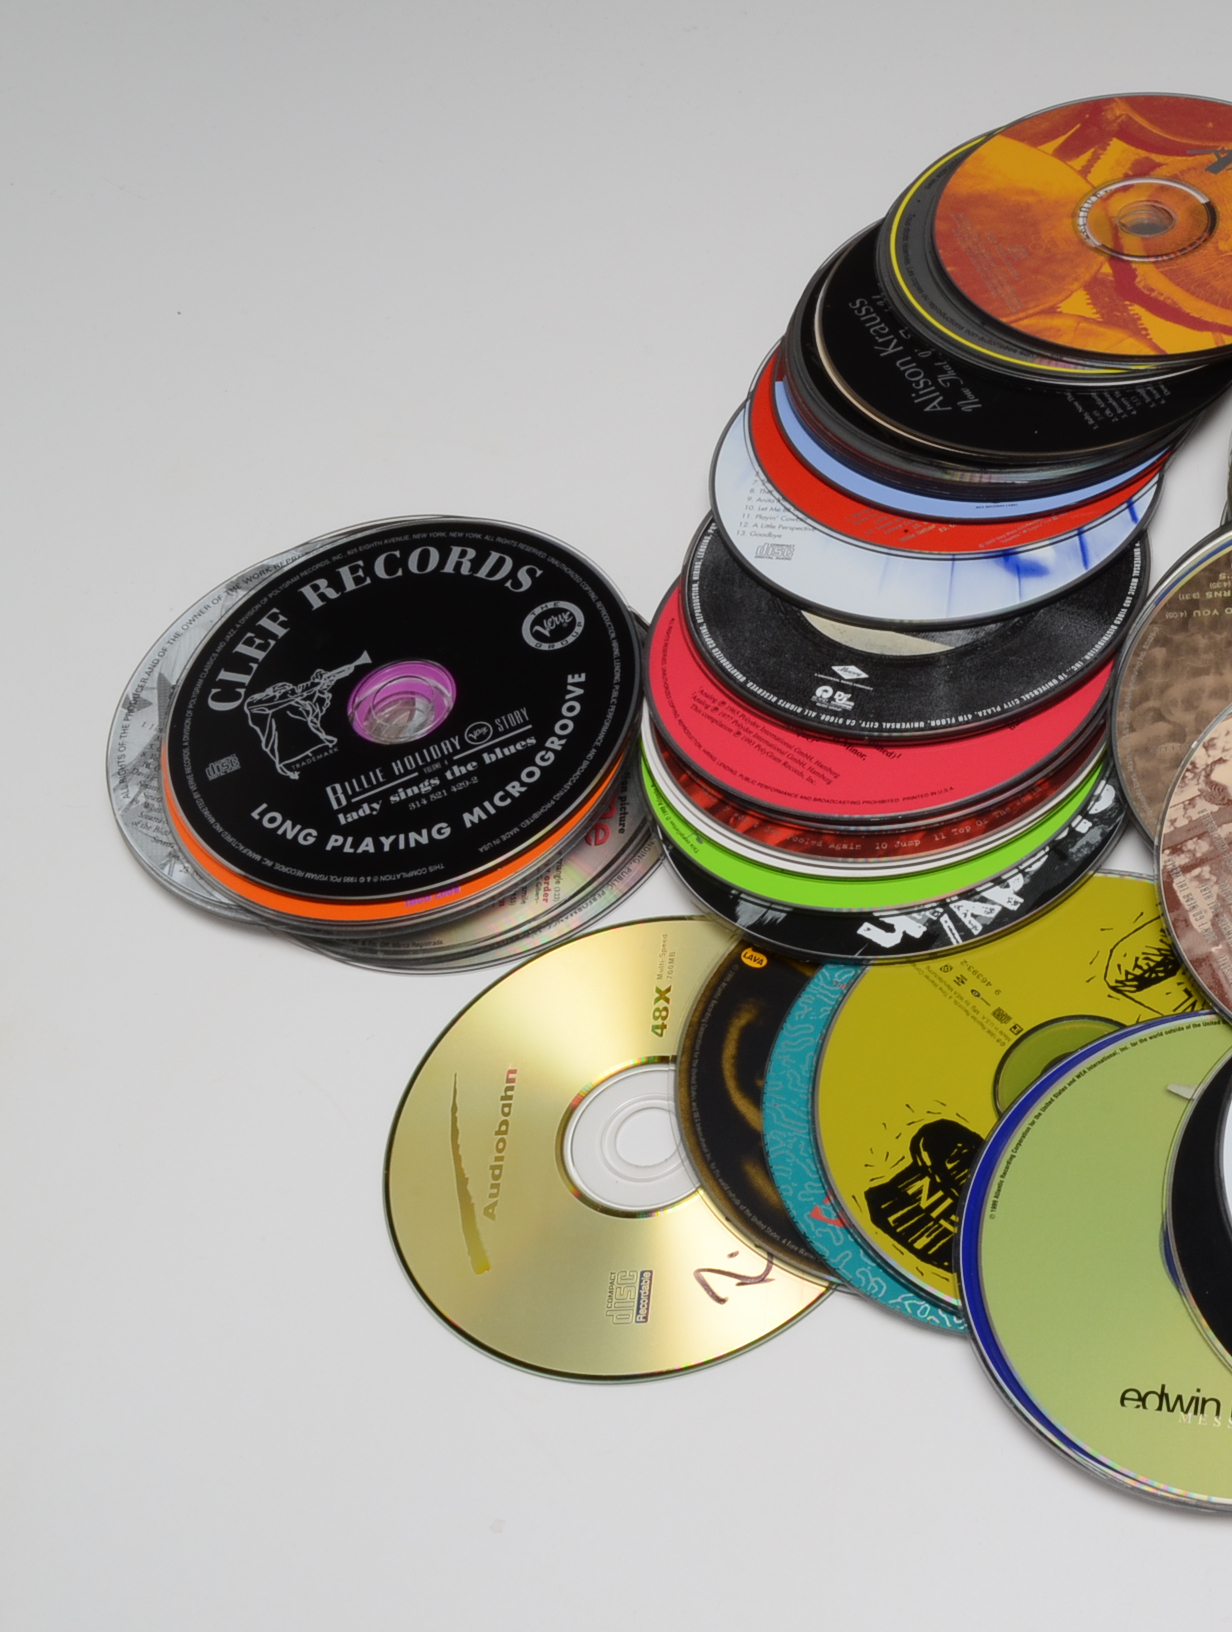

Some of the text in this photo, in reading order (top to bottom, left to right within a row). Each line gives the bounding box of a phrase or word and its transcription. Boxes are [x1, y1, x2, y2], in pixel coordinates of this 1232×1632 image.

[849, 298, 952, 412] Alison Krauss
[750, 530, 782, 539] Goodbye
[1116, 547, 1142, 625] UNIVERSAL MUSIC AND VIDEO
[181, 603, 212, 633] OWNER
[207, 545, 544, 712] CLEF RECORDS
[1193, 609, 1219, 617] YOU
[713, 649, 747, 683] UNAUTHORIZED
[777, 699, 803, 714] RIGHTS
[882, 720, 925, 729] UNIVERSAL
[250, 672, 586, 853] LONG PLAYING MICROGROOVE
[291, 746, 339, 770] TRADEMARK
[325, 707, 530, 811] BILLIE HOLIDAY STORY
[337, 735, 537, 826] lady sings the blues
[408, 796, 428, 811] 314
[429, 788, 448, 802] 521
[617, 792, 632, 835] picture
[894, 839, 921, 849] Jump
[951, 825, 972, 836] Top
[666, 951, 677, 980] 700MB
[742, 952, 765, 967] LAVA
[959, 958, 994, 988] 46393-2
[650, 933, 673, 1038] 48X Multi-Speed
[482, 1066, 519, 1222] Audiobahn
[995, 1179, 1003, 1200] Atlantic
[1000, 1154, 1016, 1181] Recording
[1011, 1125, 1031, 1154] Corporation
[606, 1270, 617, 1309] COMPACT
[610, 1270, 639, 1326] disc
[636, 1270, 652, 1324] Recordable
[1120, 1384, 1221, 1417] edwin
